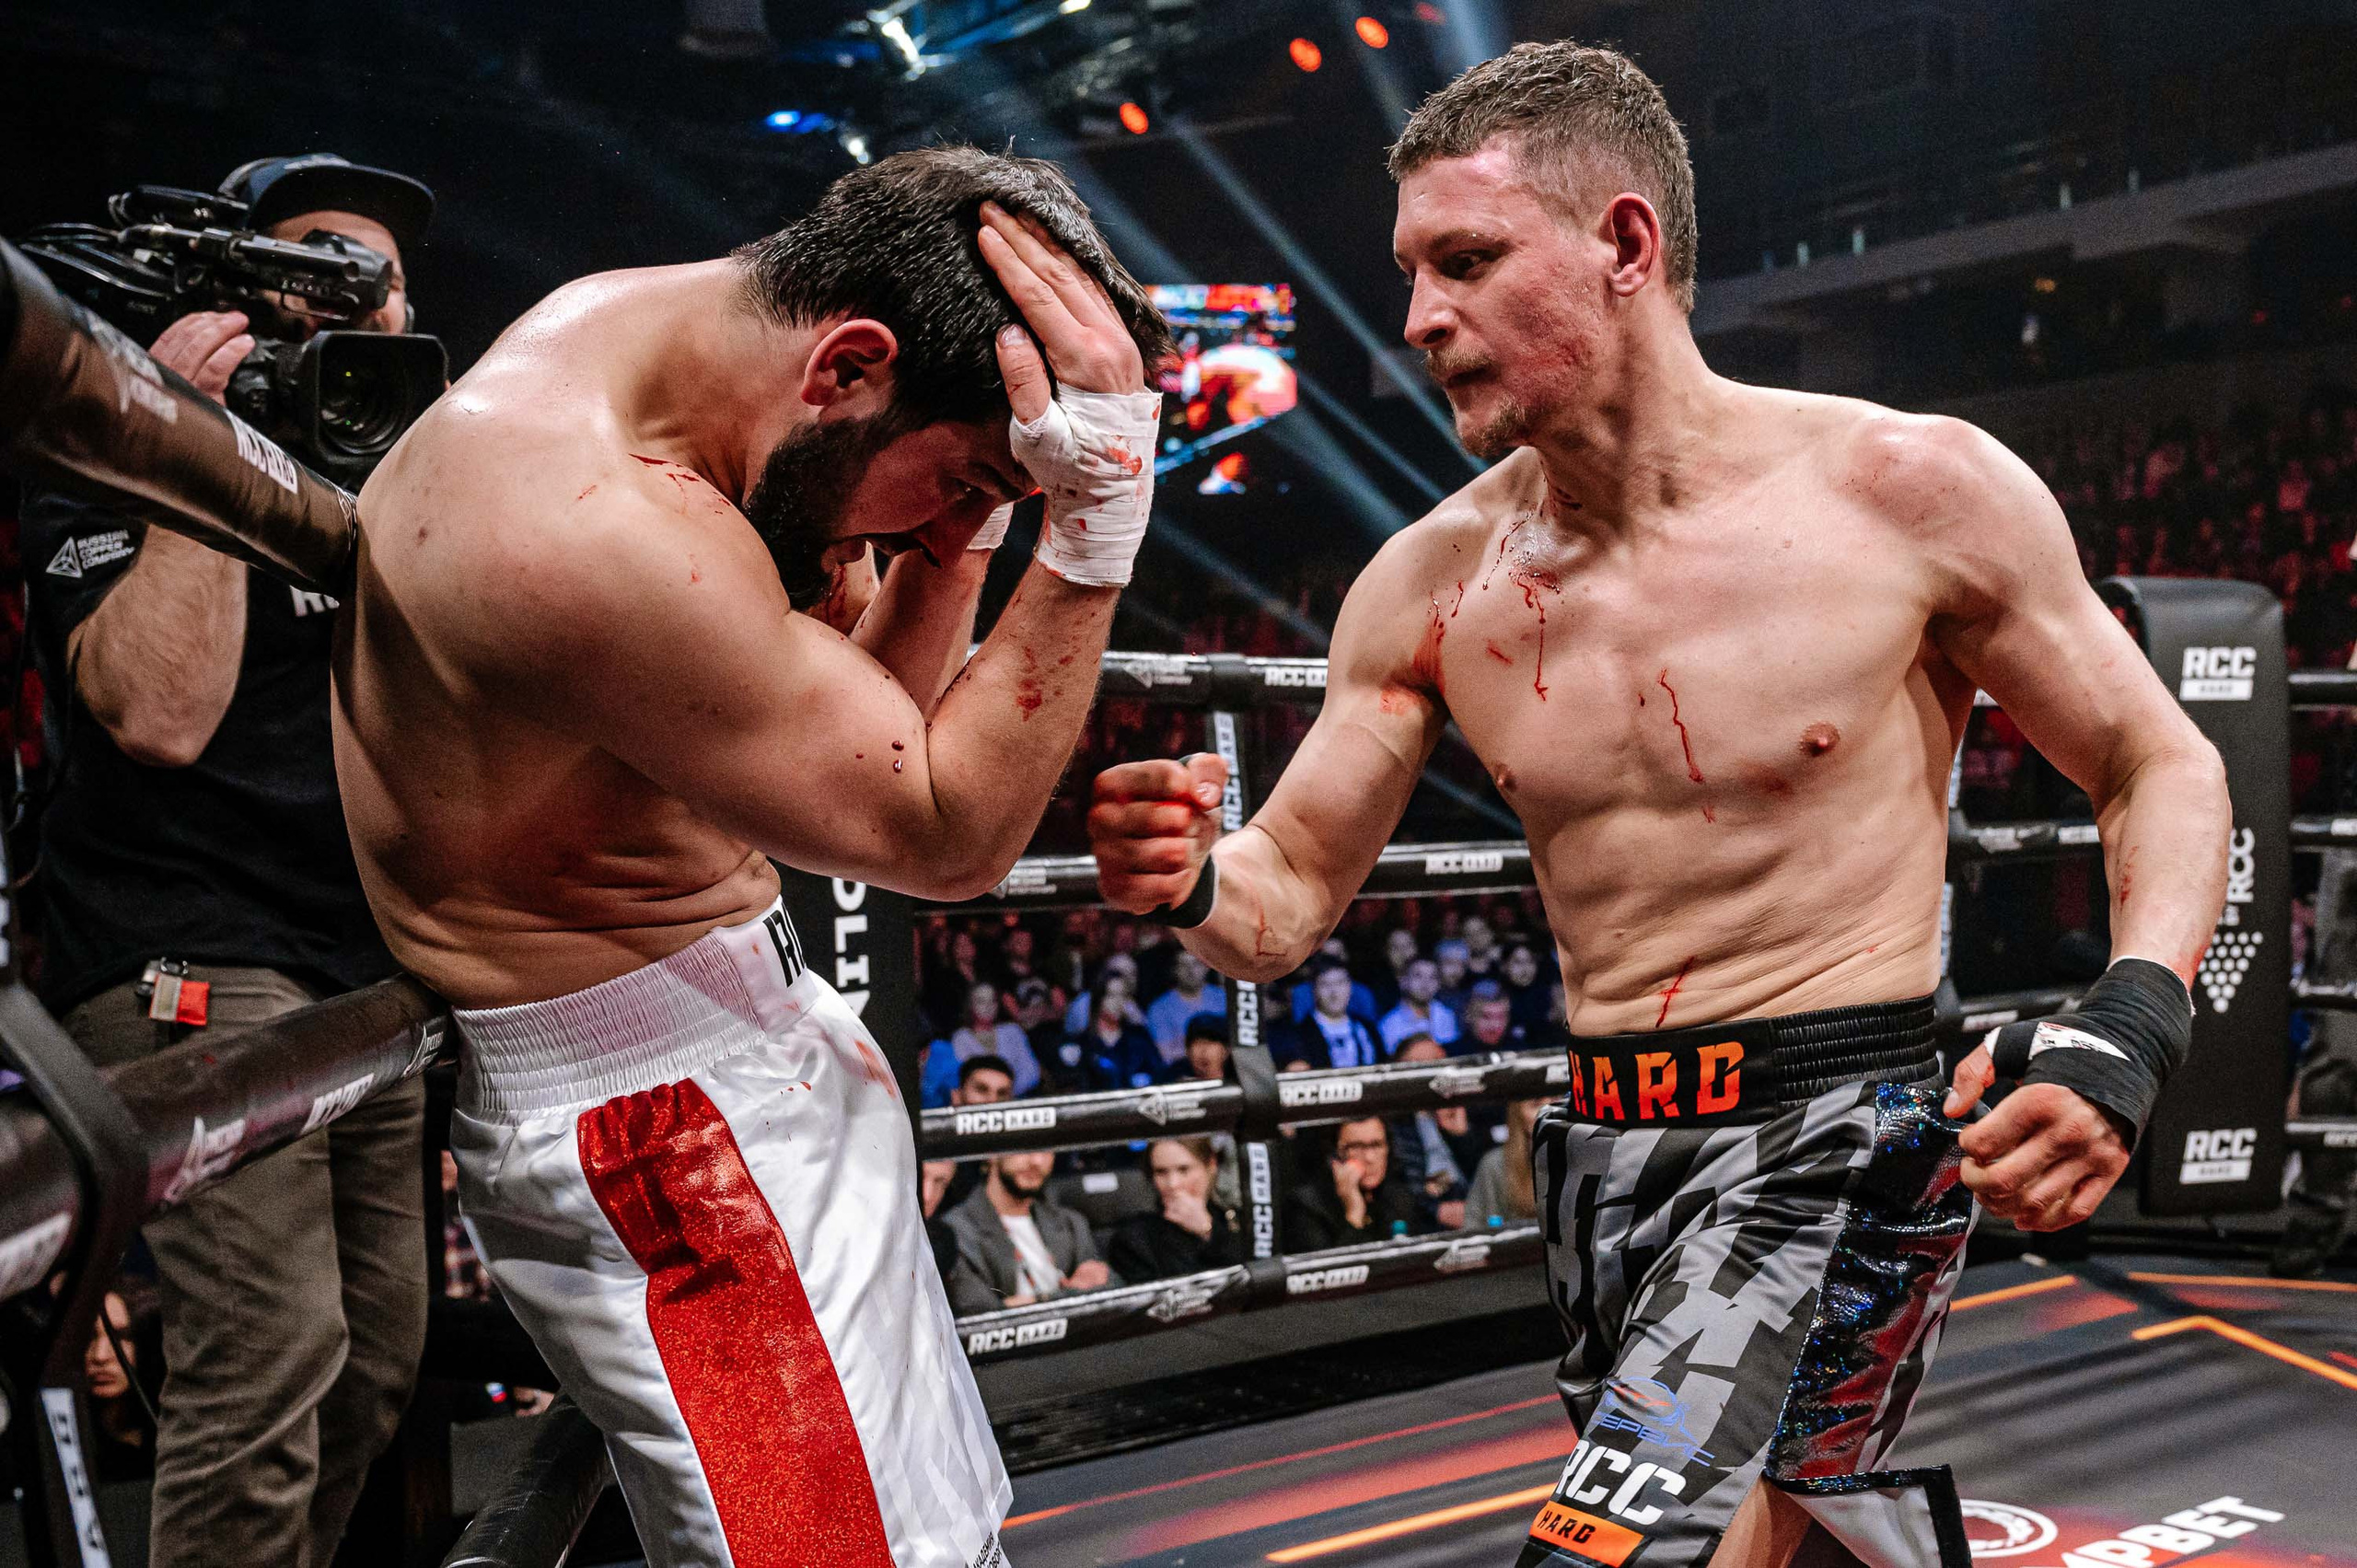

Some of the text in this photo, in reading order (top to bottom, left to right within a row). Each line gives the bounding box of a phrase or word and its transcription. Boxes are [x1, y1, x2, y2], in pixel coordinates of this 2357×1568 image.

[2182, 646, 2257, 679] RCC
[2226, 828, 2256, 902] RCC
[1237, 991, 1259, 1046] RCC
[1568, 1041, 1745, 1121] HARD
[956, 1110, 1003, 1135] RCC
[2183, 1128, 2258, 1162] RCC
[1253, 1203, 1272, 1258] RCC
[968, 1328, 1016, 1355] RCC
[1556, 1439, 1687, 1526] RCC
[1537, 1509, 1596, 1544] HARD
[2020, 1495, 2285, 1568] PBET
